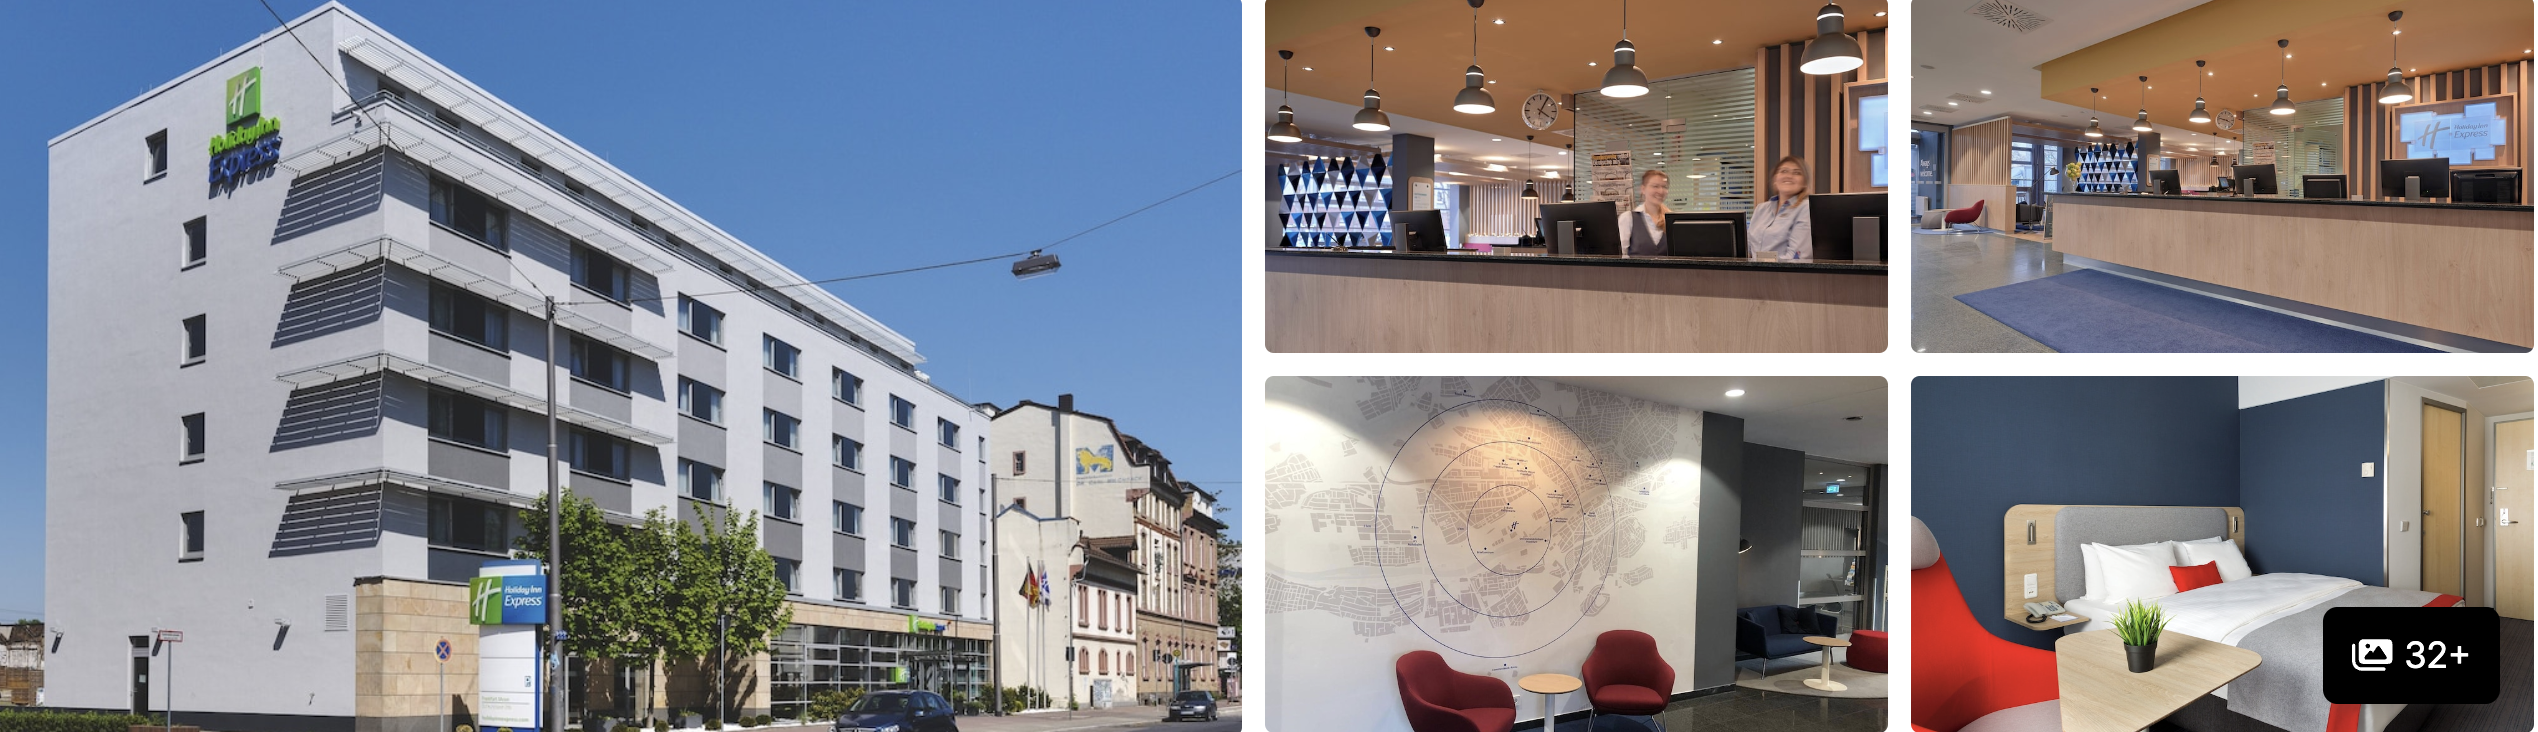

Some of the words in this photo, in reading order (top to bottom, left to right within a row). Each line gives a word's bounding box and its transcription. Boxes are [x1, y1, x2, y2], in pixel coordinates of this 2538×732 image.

[208, 125, 258, 156] Holiday
[258, 117, 280, 135] Inn
[2453, 130, 2488, 139] Express
[208, 136, 283, 184] Express
[504, 586, 530, 595] Holiday
[530, 585, 543, 593] Inn
[504, 595, 543, 609] Express
